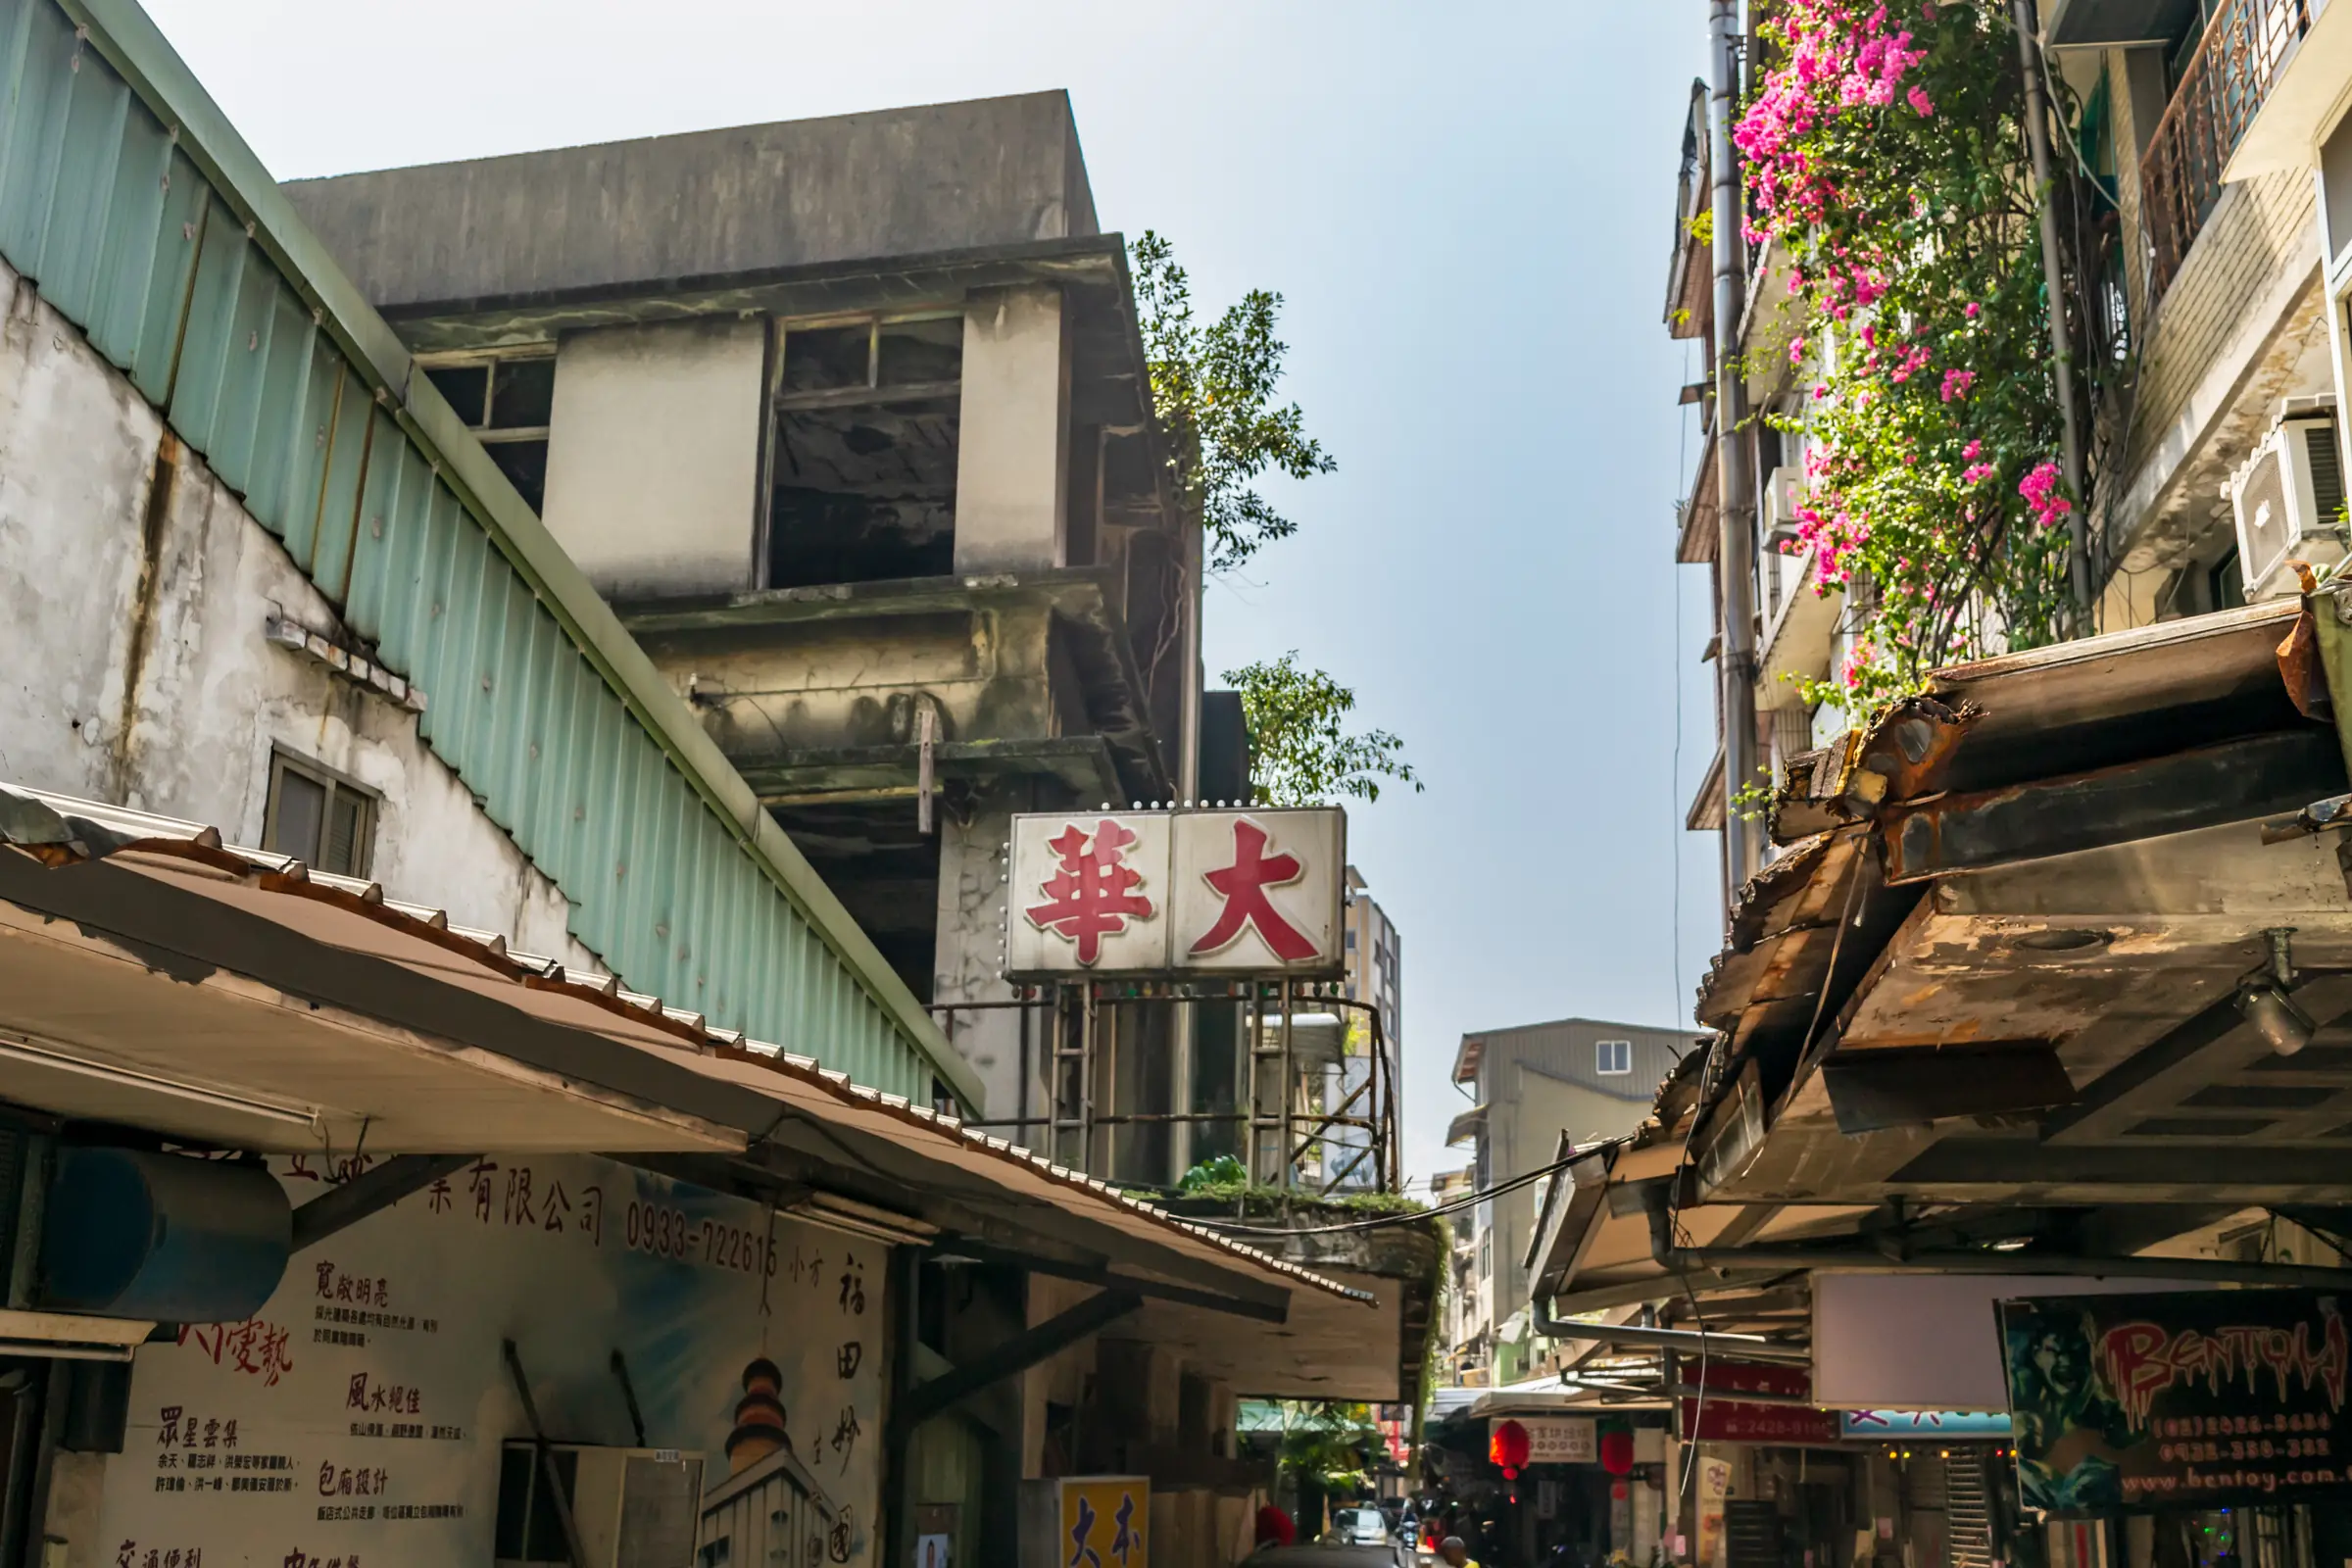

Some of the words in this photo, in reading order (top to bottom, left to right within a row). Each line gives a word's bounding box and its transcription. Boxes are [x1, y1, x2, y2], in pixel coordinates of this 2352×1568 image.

[316, 1259, 388, 1308] 寬敞明亮
[346, 1372, 420, 1415] 風水絕佳
[318, 1459, 388, 1496] 包廂設計
